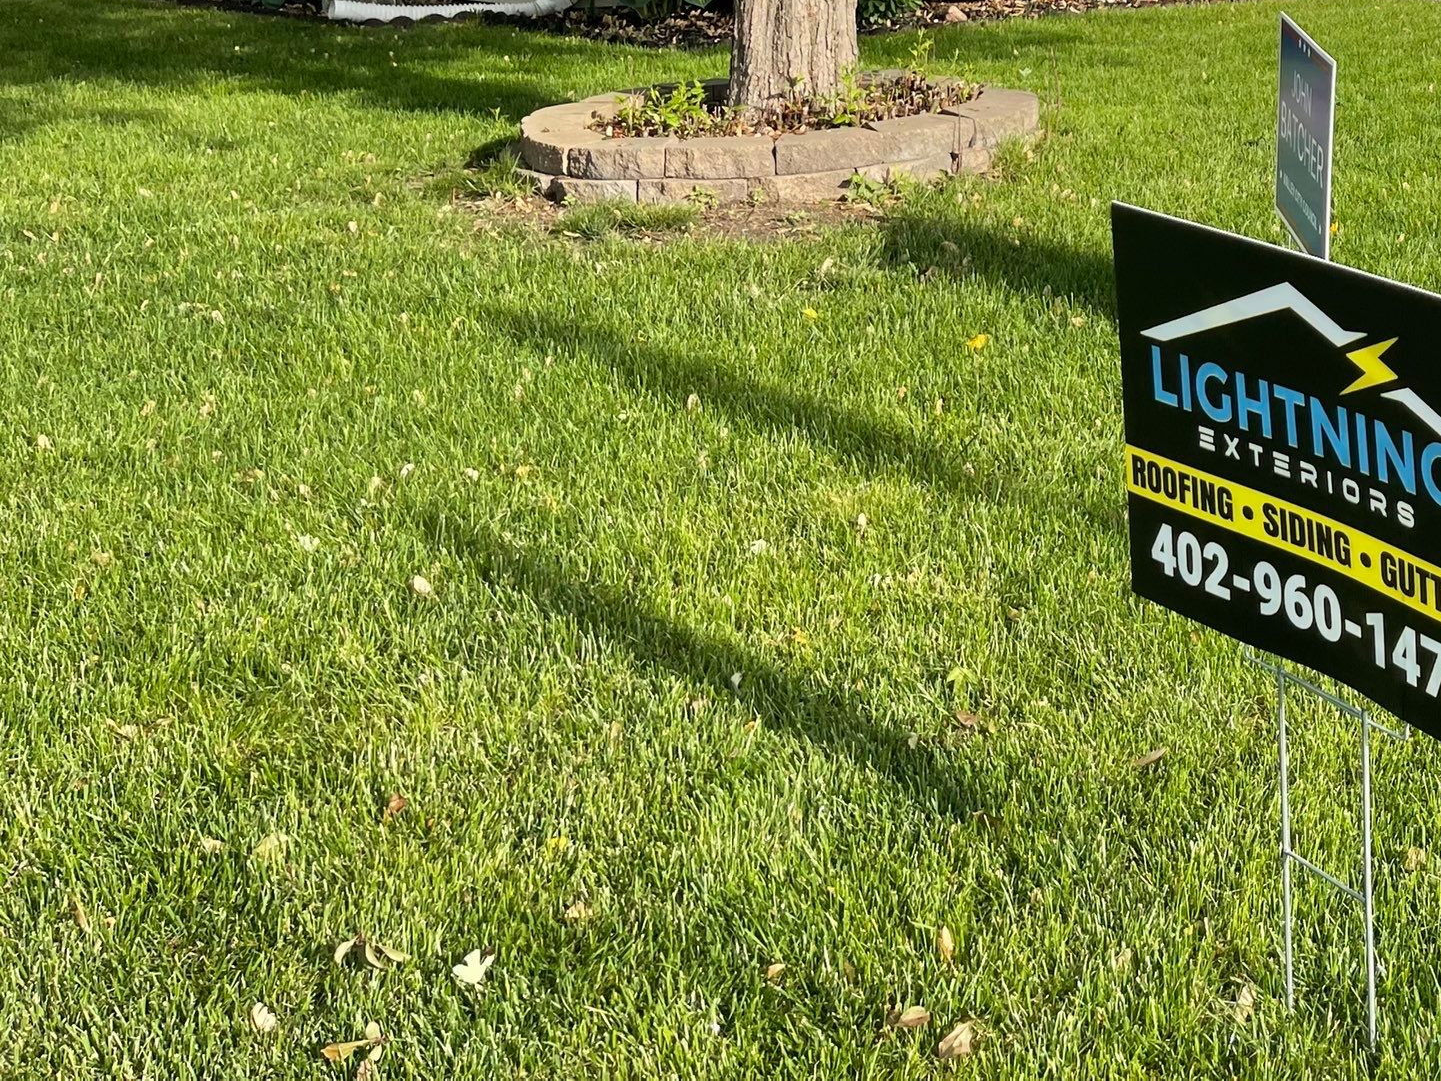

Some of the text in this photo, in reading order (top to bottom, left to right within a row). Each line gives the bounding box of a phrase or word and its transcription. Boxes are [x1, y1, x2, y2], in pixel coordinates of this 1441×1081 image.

[1291, 70, 1313, 117] JOHN
[1280, 101, 1324, 189] BATCHER
[1131, 453, 1234, 522] ROOFING
[1262, 502, 1352, 569] SIDING
[1198, 425, 1416, 529] EXTERIORS
